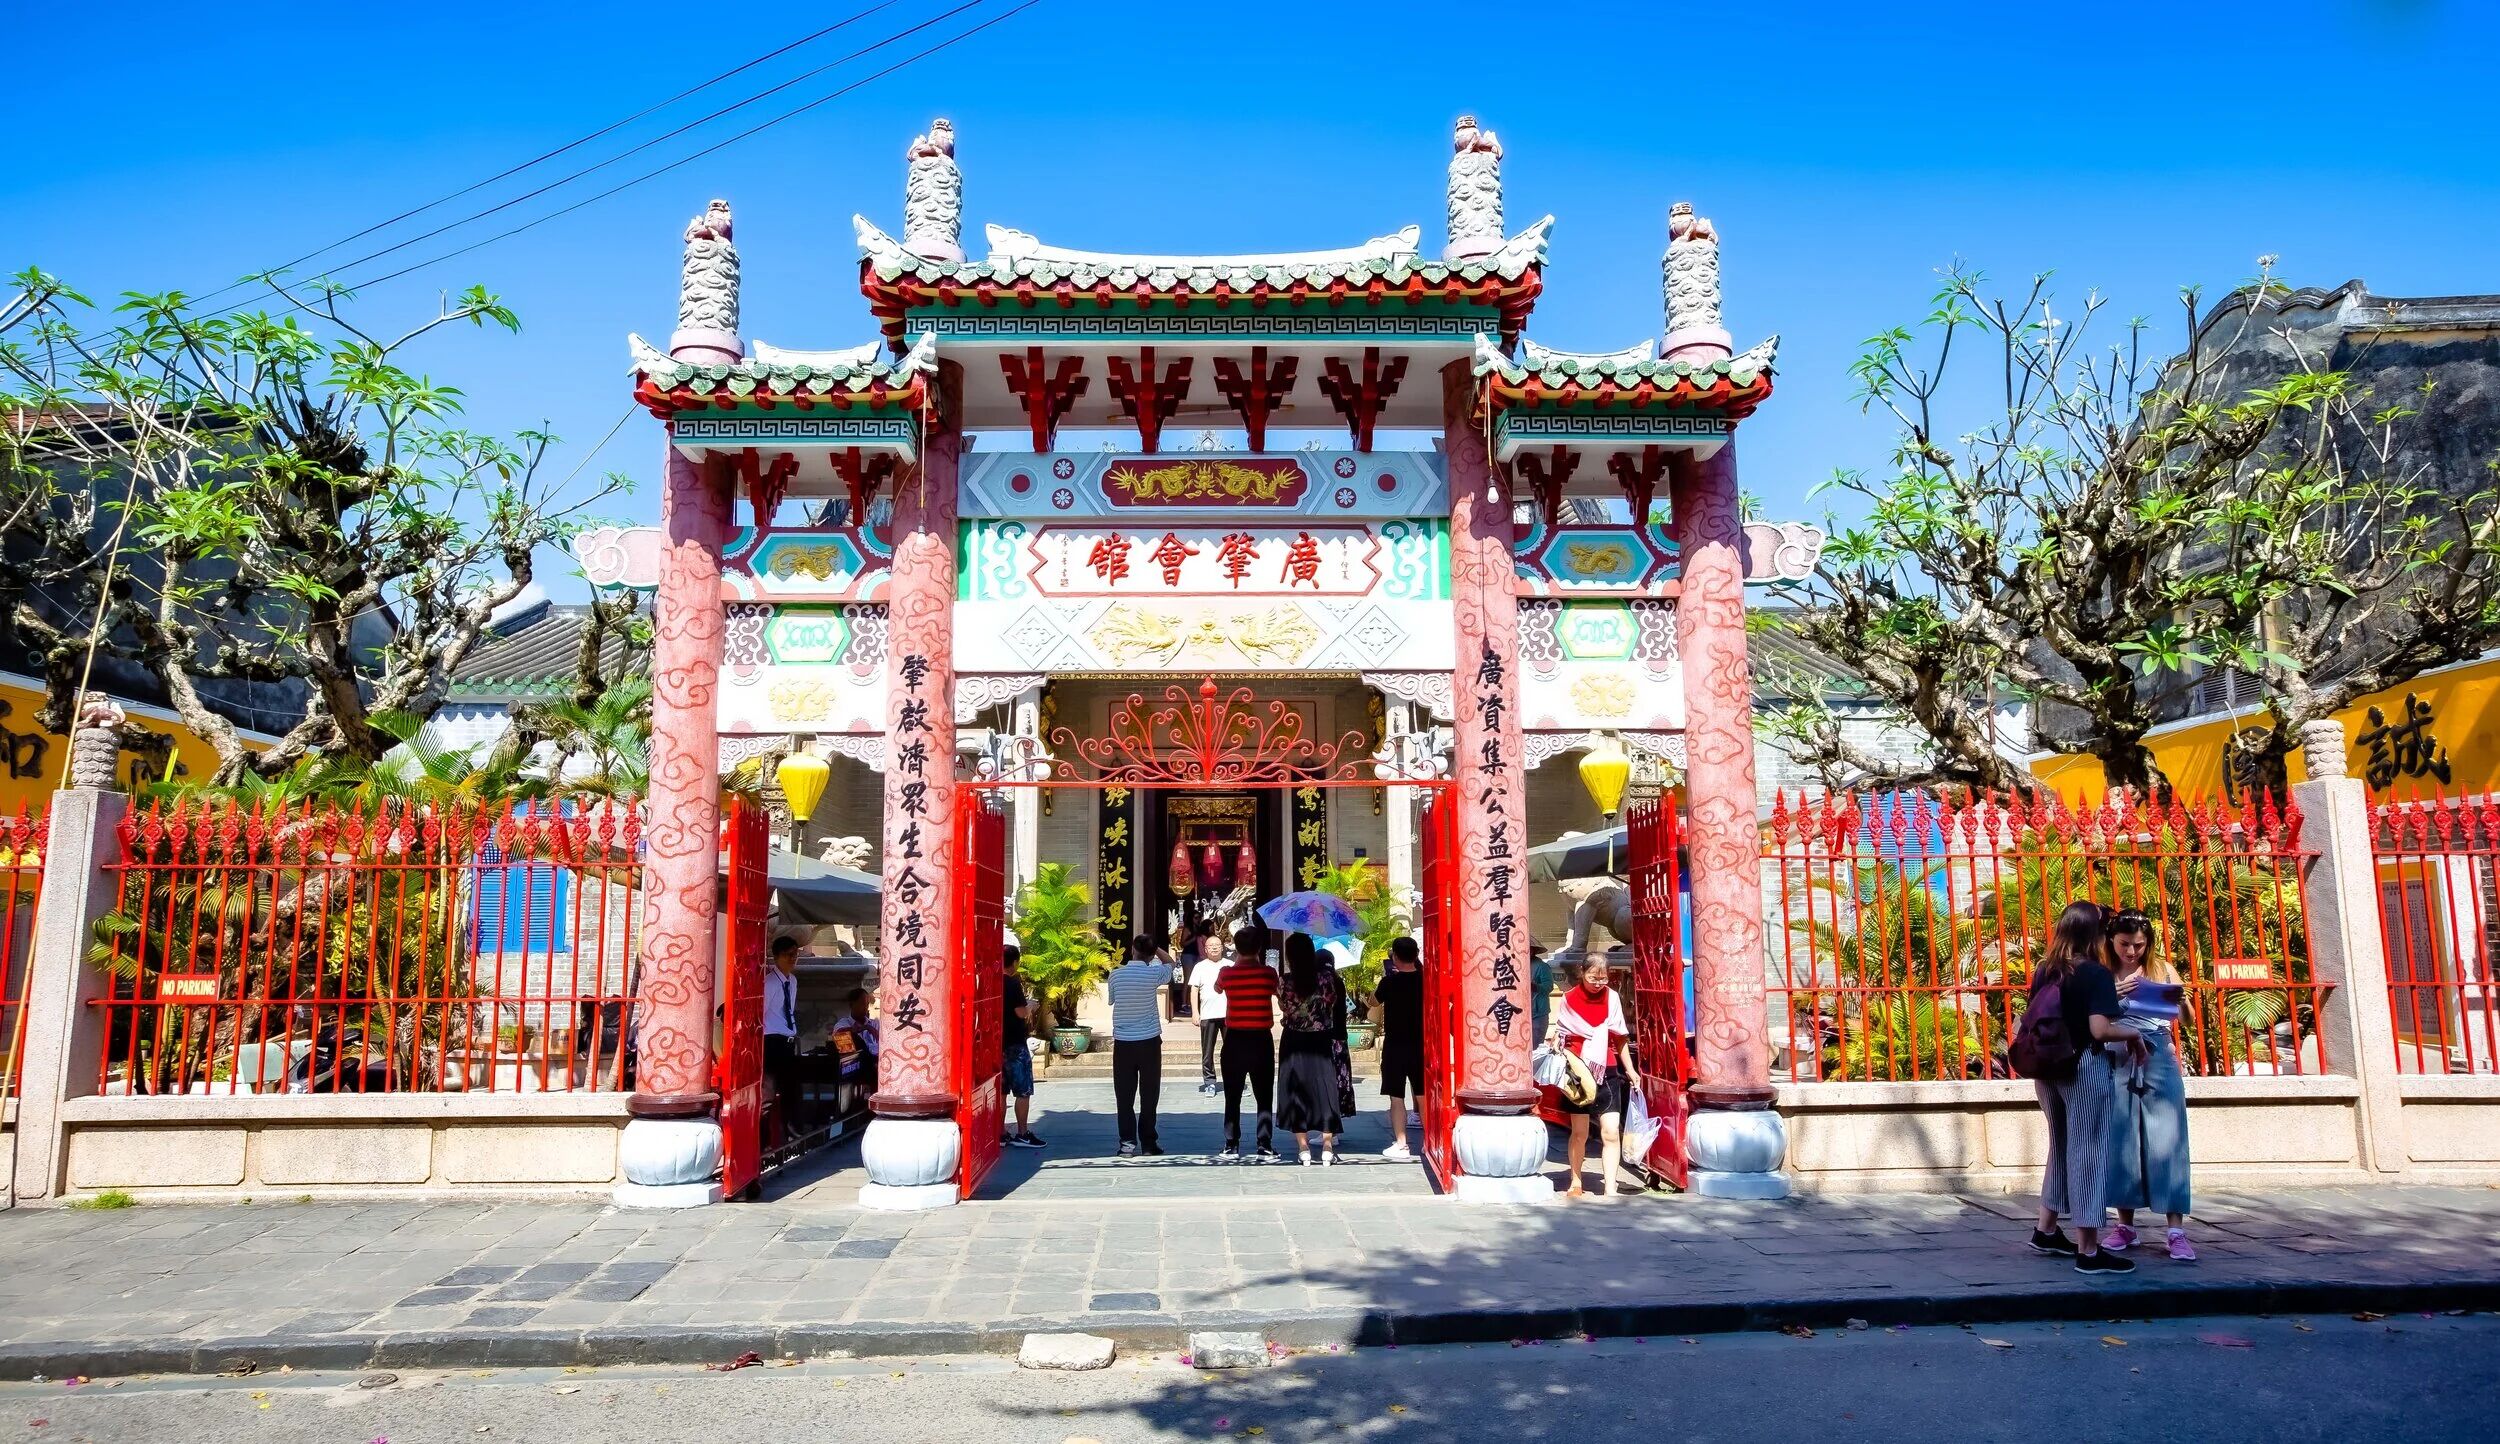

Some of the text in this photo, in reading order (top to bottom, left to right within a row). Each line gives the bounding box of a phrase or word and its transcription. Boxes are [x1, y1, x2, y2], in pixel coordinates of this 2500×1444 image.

[2218, 964, 2269, 979] NO PARKING
[162, 980, 216, 995] NO PARKING
